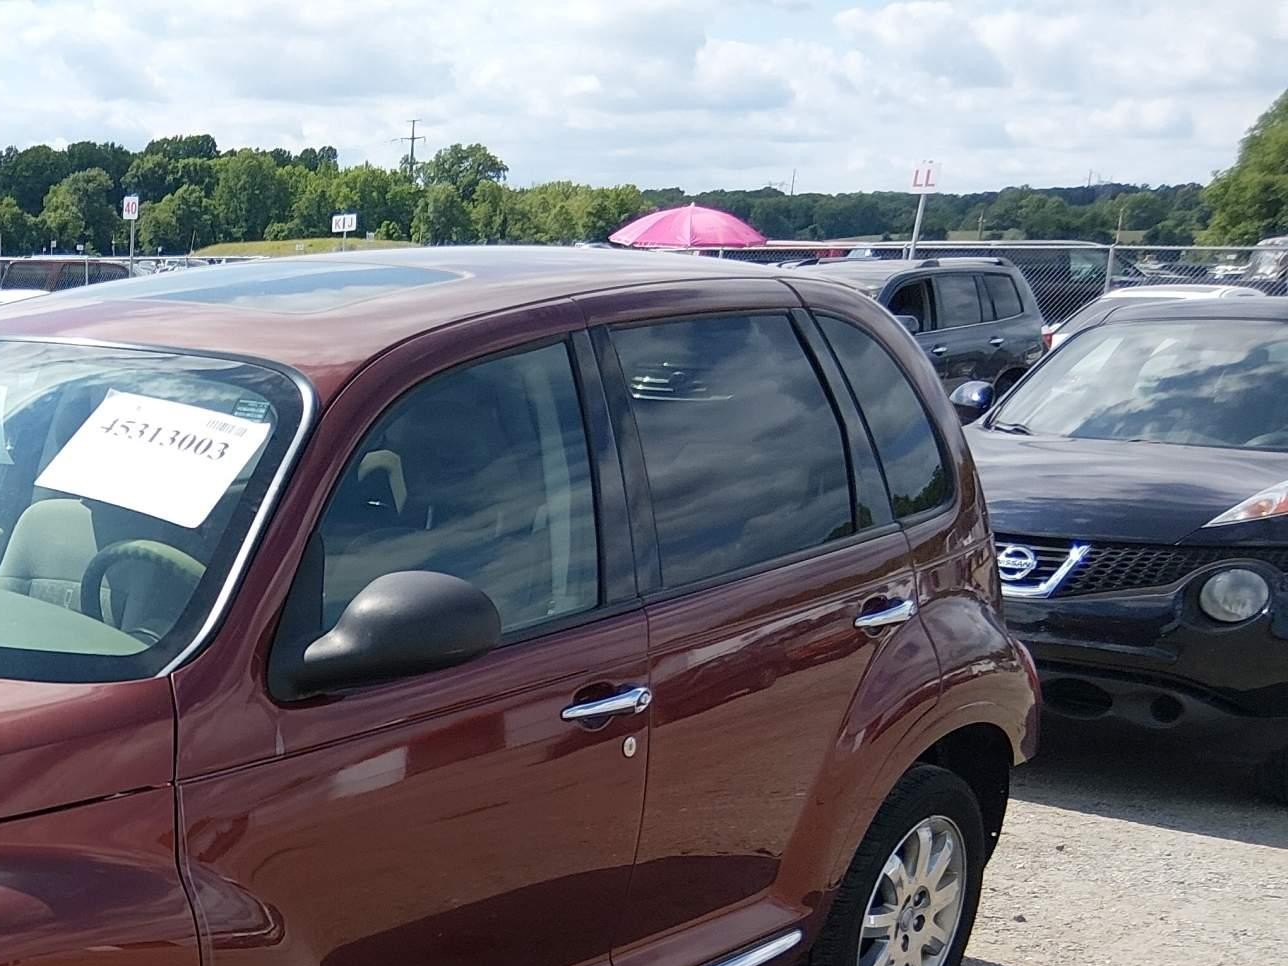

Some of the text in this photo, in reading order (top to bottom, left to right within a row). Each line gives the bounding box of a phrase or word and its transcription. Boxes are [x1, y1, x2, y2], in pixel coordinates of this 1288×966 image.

[912, 169, 936, 188] LL
[124, 201, 137, 215] 40
[100, 417, 230, 461] 45313003
